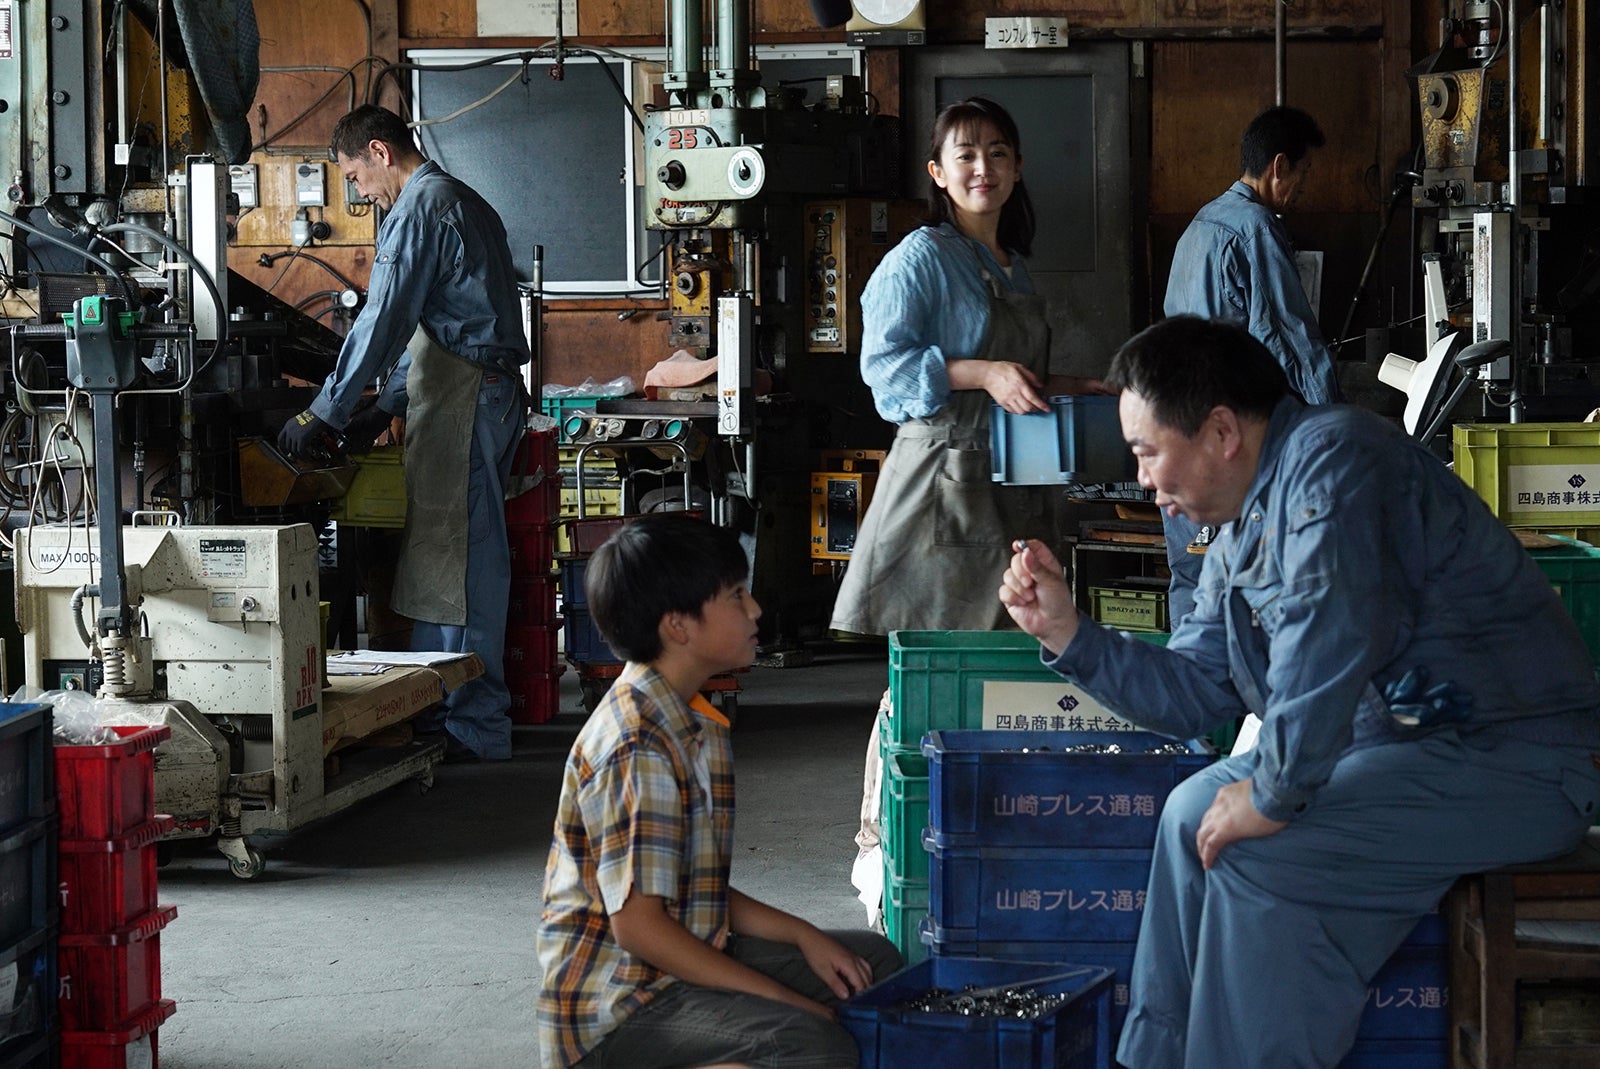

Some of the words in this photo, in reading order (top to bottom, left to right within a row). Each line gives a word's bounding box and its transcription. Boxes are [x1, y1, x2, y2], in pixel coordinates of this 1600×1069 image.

[998, 25, 1057, 45] コンプレサー室
[668, 110, 706, 125] 1015
[668, 129, 698, 149] 25
[41, 553, 63, 563] MAX
[996, 714, 1136, 731] 四島商事株式会
[993, 794, 1156, 817] 山崎プレス通箱
